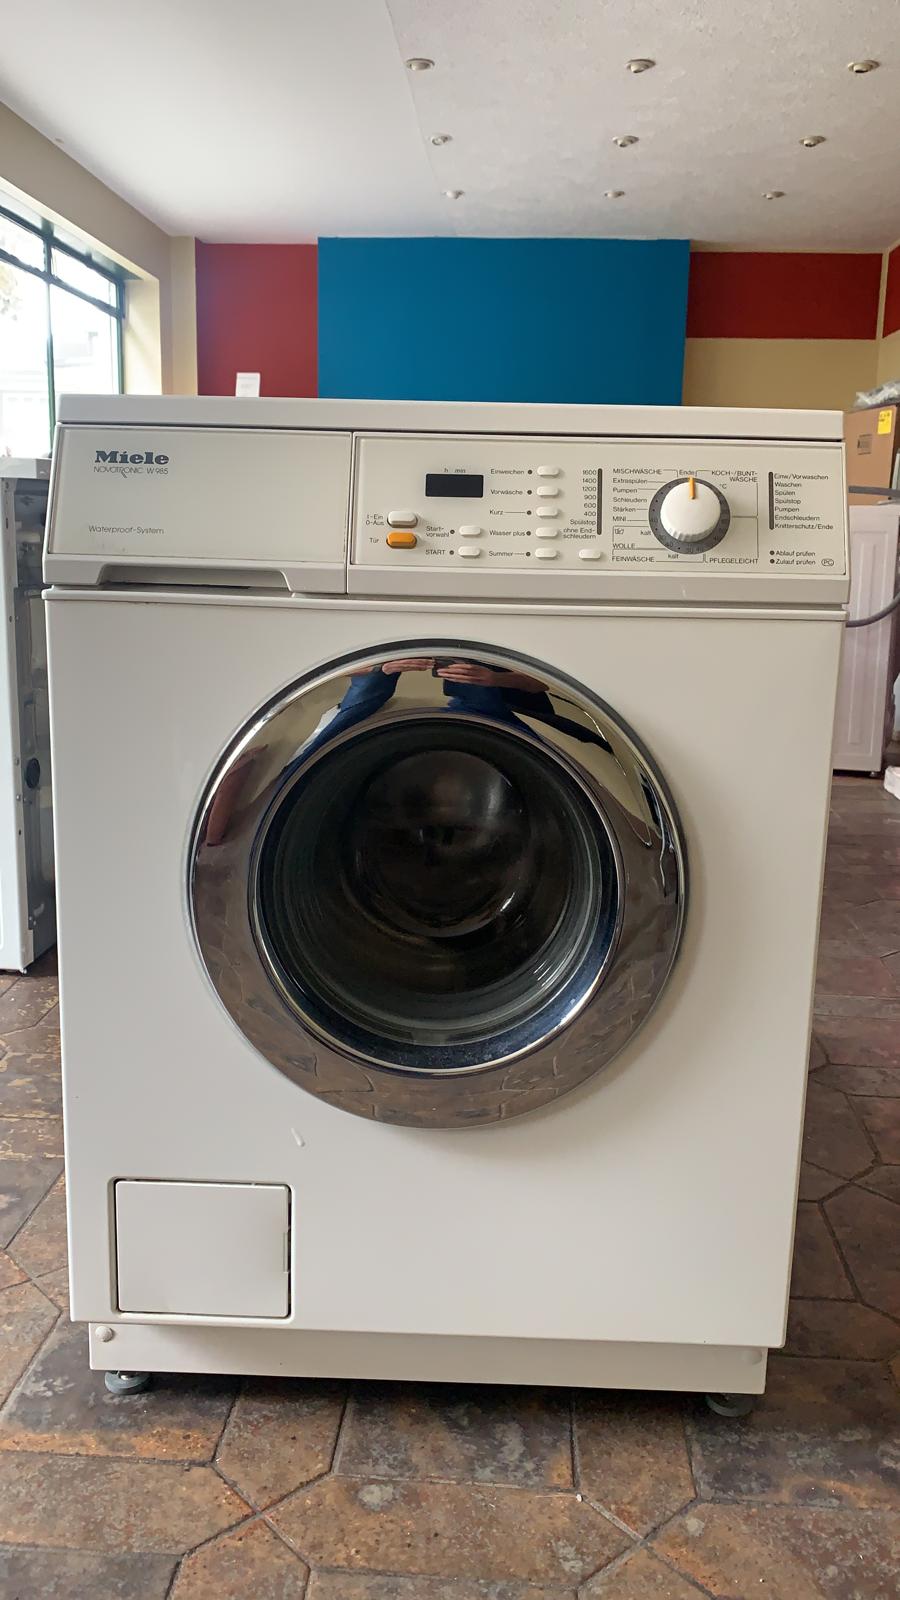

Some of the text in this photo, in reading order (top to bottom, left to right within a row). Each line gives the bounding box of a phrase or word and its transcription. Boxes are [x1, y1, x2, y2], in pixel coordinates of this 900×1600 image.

[94, 450, 170, 465] Miele
[93, 466, 143, 478] NOVOTRONIC
[88, 524, 165, 535] Waterproof-System
